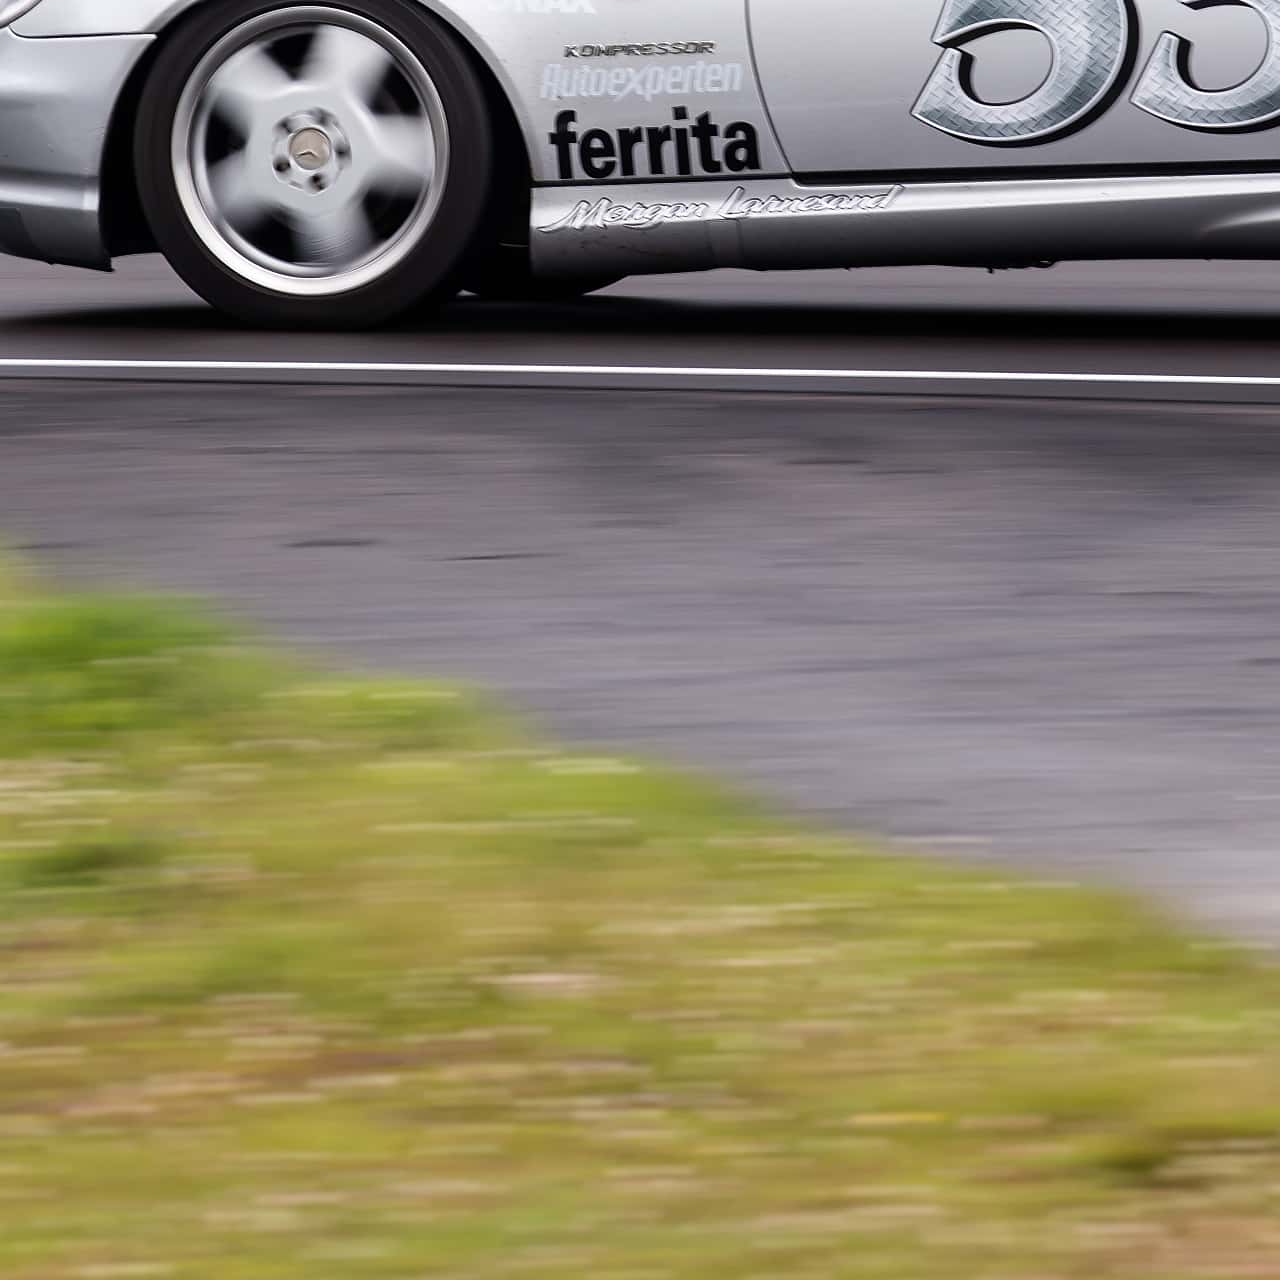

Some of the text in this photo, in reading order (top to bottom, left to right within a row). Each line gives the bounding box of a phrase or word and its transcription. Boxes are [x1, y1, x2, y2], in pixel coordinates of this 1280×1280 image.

[563, 40, 715, 58] KOMPRESSOR
[540, 62, 742, 103] Autoexperten
[549, 106, 762, 179] ferrita
[536, 196, 709, 232] Morgan
